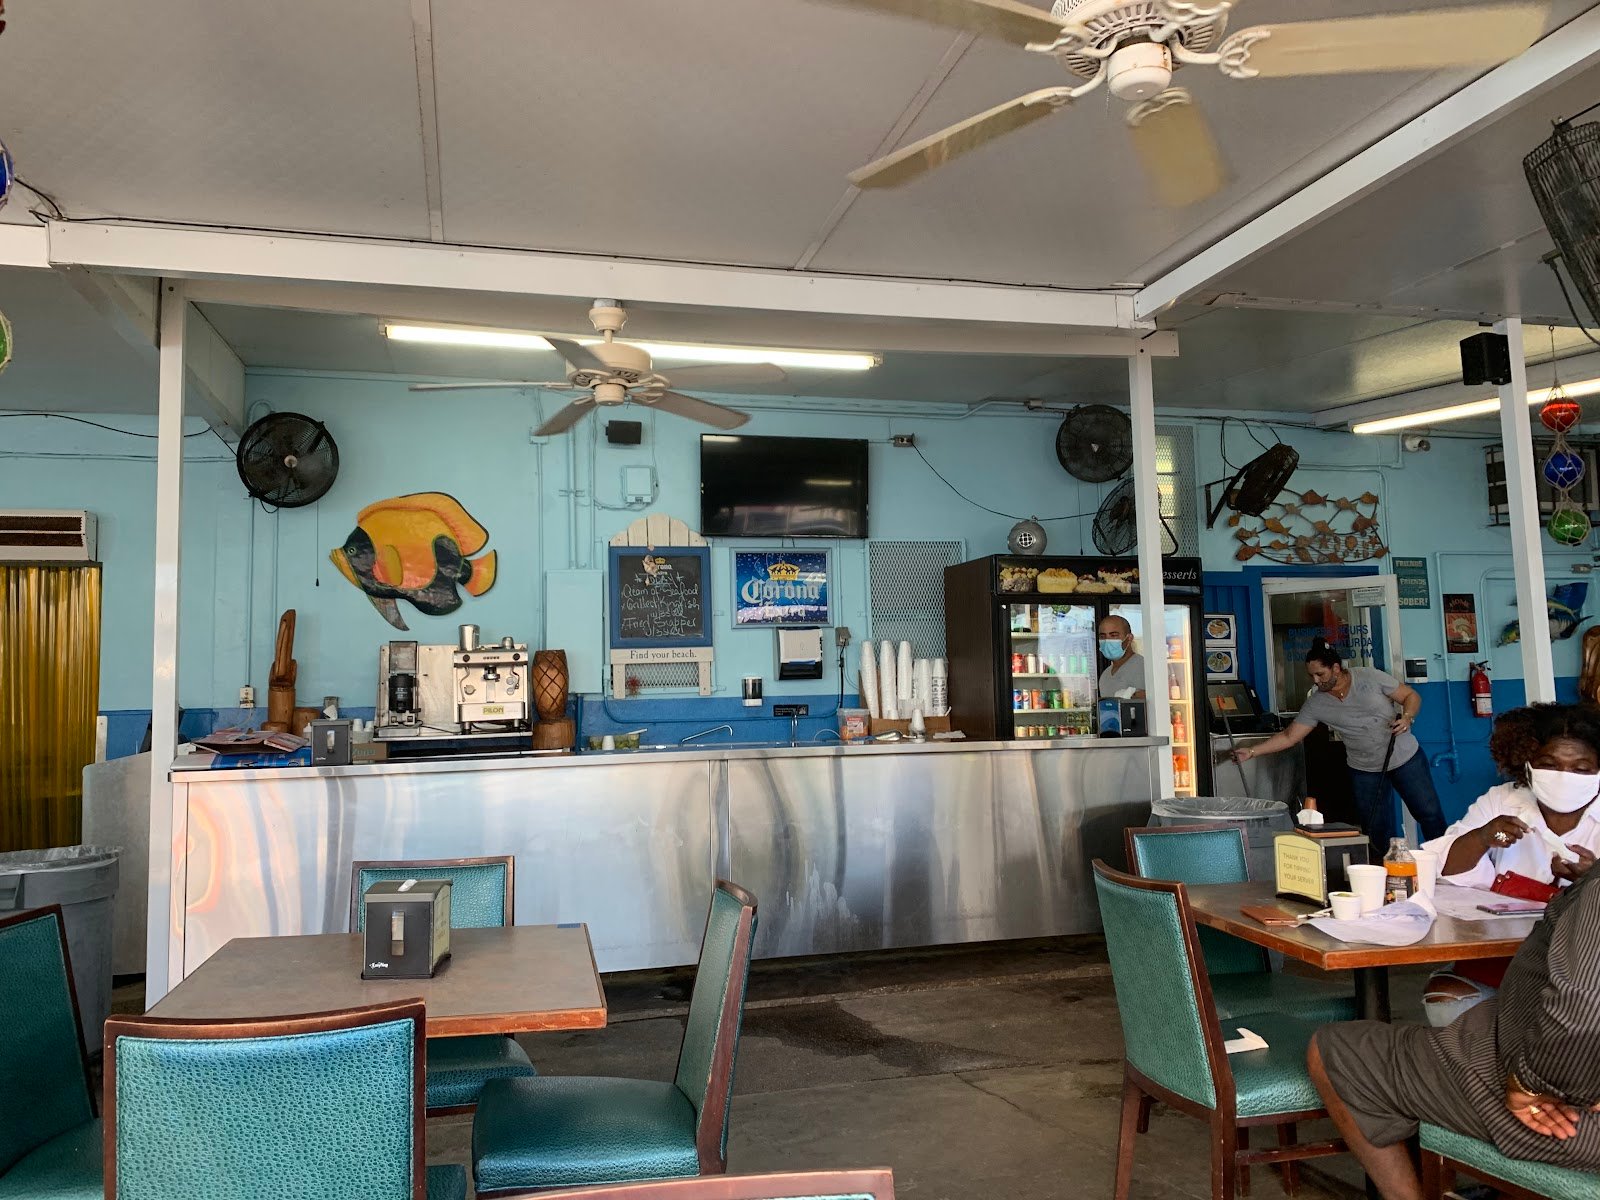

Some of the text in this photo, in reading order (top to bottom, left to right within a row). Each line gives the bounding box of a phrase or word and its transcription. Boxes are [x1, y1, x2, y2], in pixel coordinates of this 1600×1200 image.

[1162, 568, 1197, 579] esserts
[741, 575, 820, 606] Corona
[1398, 597, 1428, 606] SOBER!
[630, 649, 697, 661] Find your beach.
[1283, 852, 1298, 860] THANK
[1284, 872, 1315, 885] YOUR SERVER
